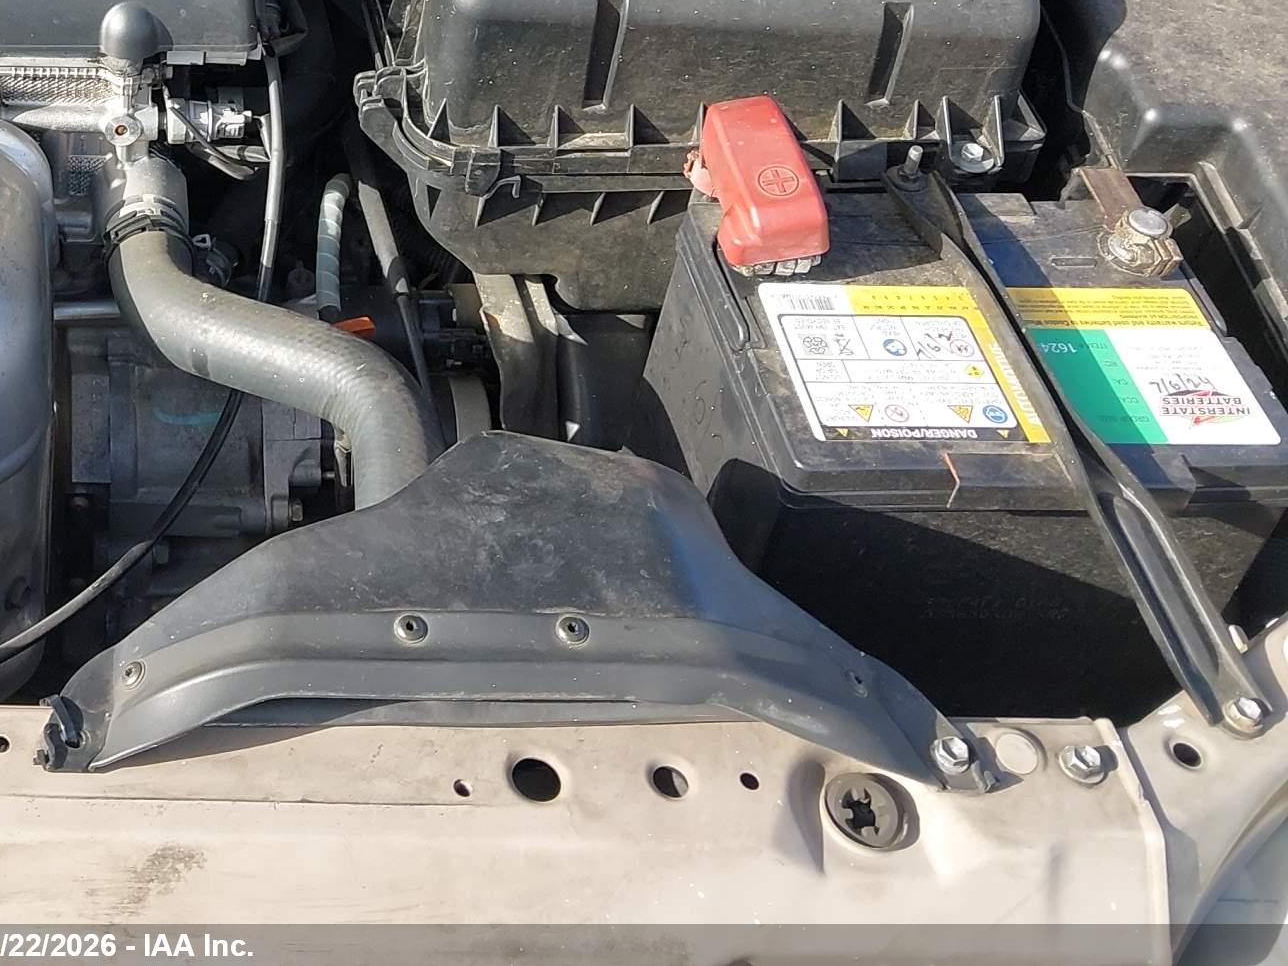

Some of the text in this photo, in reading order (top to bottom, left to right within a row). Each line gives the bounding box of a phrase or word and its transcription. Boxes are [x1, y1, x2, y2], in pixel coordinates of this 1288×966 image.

[1041, 342, 1078, 353] 1624
[1160, 395, 1242, 405] BATTERIES
[1160, 406, 1251, 416] INTERSTATE
[871, 428, 978, 439] DANGER/POISON
